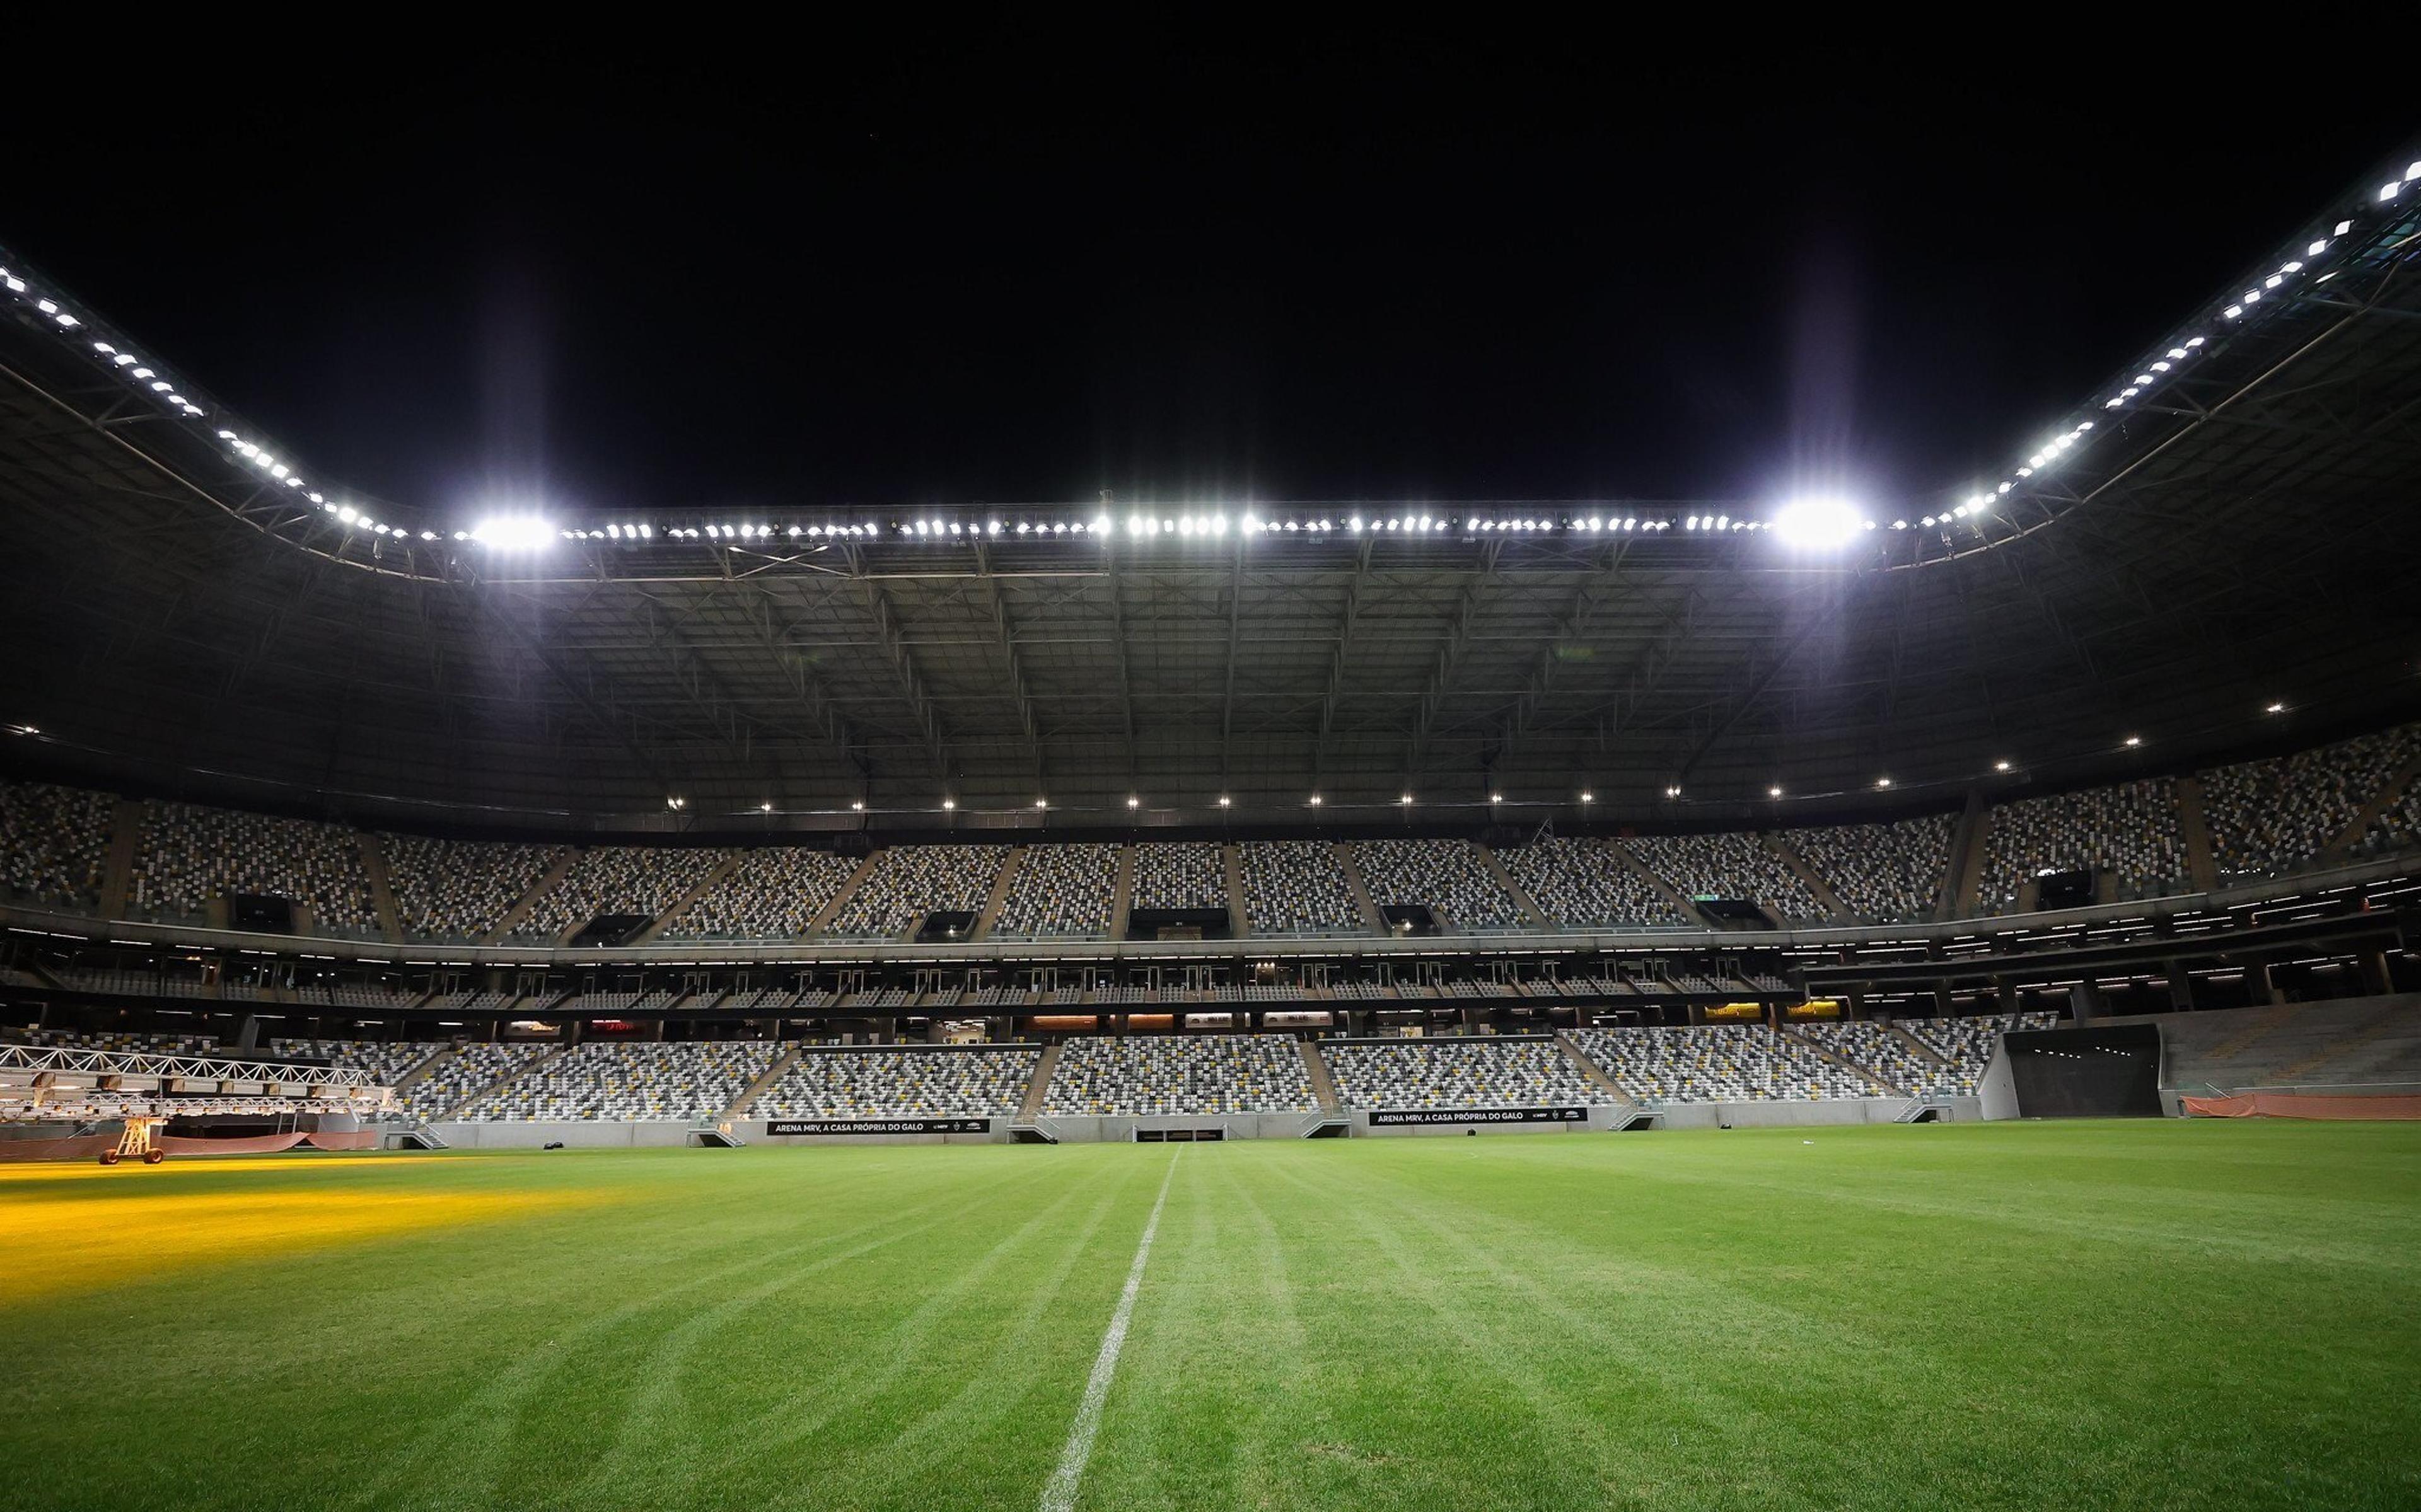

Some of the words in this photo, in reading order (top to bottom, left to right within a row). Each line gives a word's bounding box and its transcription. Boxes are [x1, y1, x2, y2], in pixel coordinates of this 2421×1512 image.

[1405, 1114, 1424, 1122] MRV,
[1454, 1112, 1487, 1121] PRÓPRIA
[803, 1124, 821, 1133] MRV,
[853, 1122, 886, 1131] PRÓPRIA
